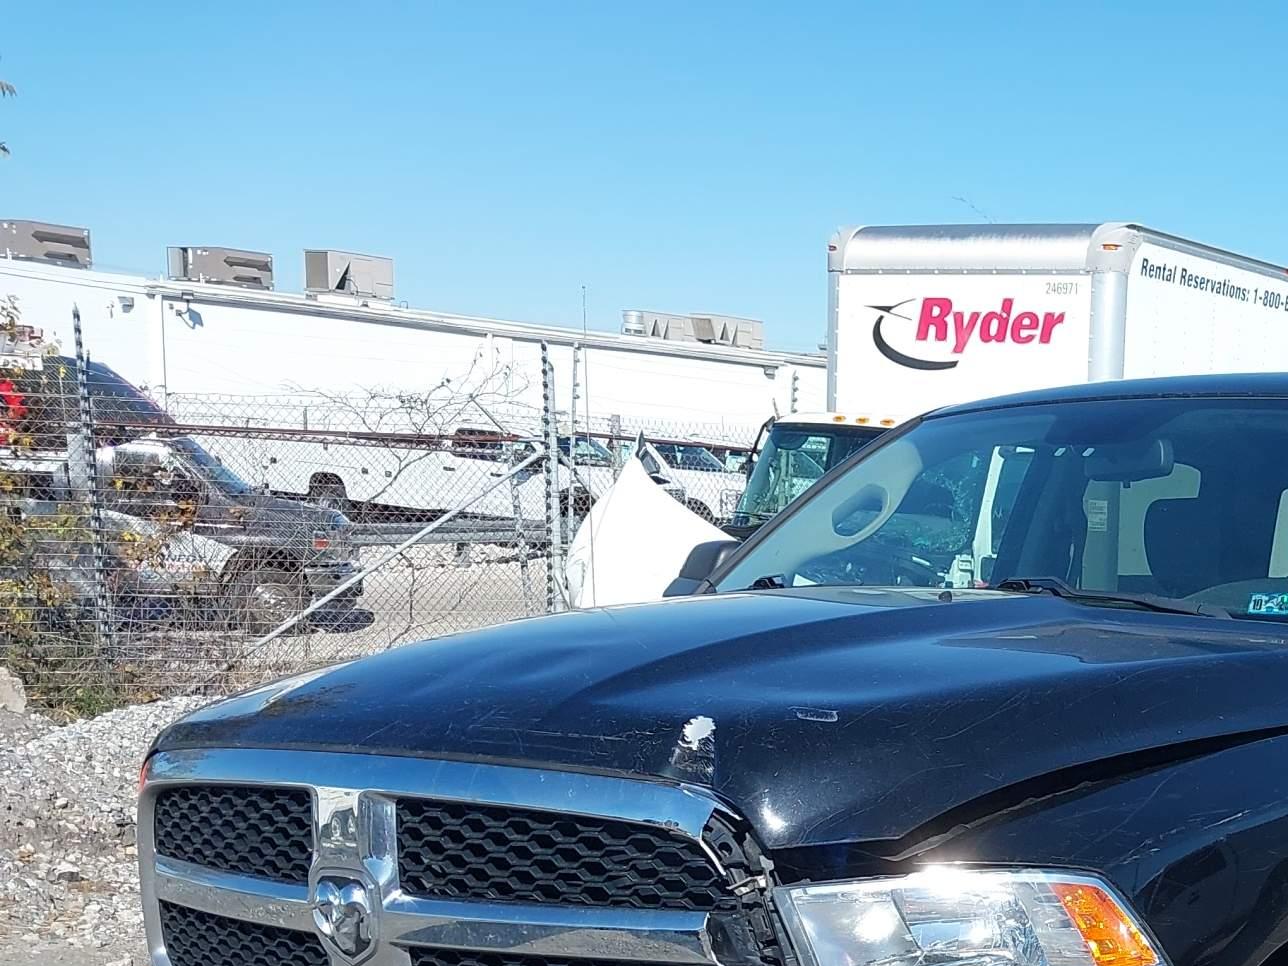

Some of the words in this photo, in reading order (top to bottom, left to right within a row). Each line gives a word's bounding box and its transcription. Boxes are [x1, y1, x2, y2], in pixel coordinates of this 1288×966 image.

[1045, 282, 1079, 295] 246971
[1140, 257, 1177, 283] Rental
[1179, 267, 1250, 302] Reservations:
[915, 297, 1066, 354] Ryder
[1252, 599, 1263, 610] 10
